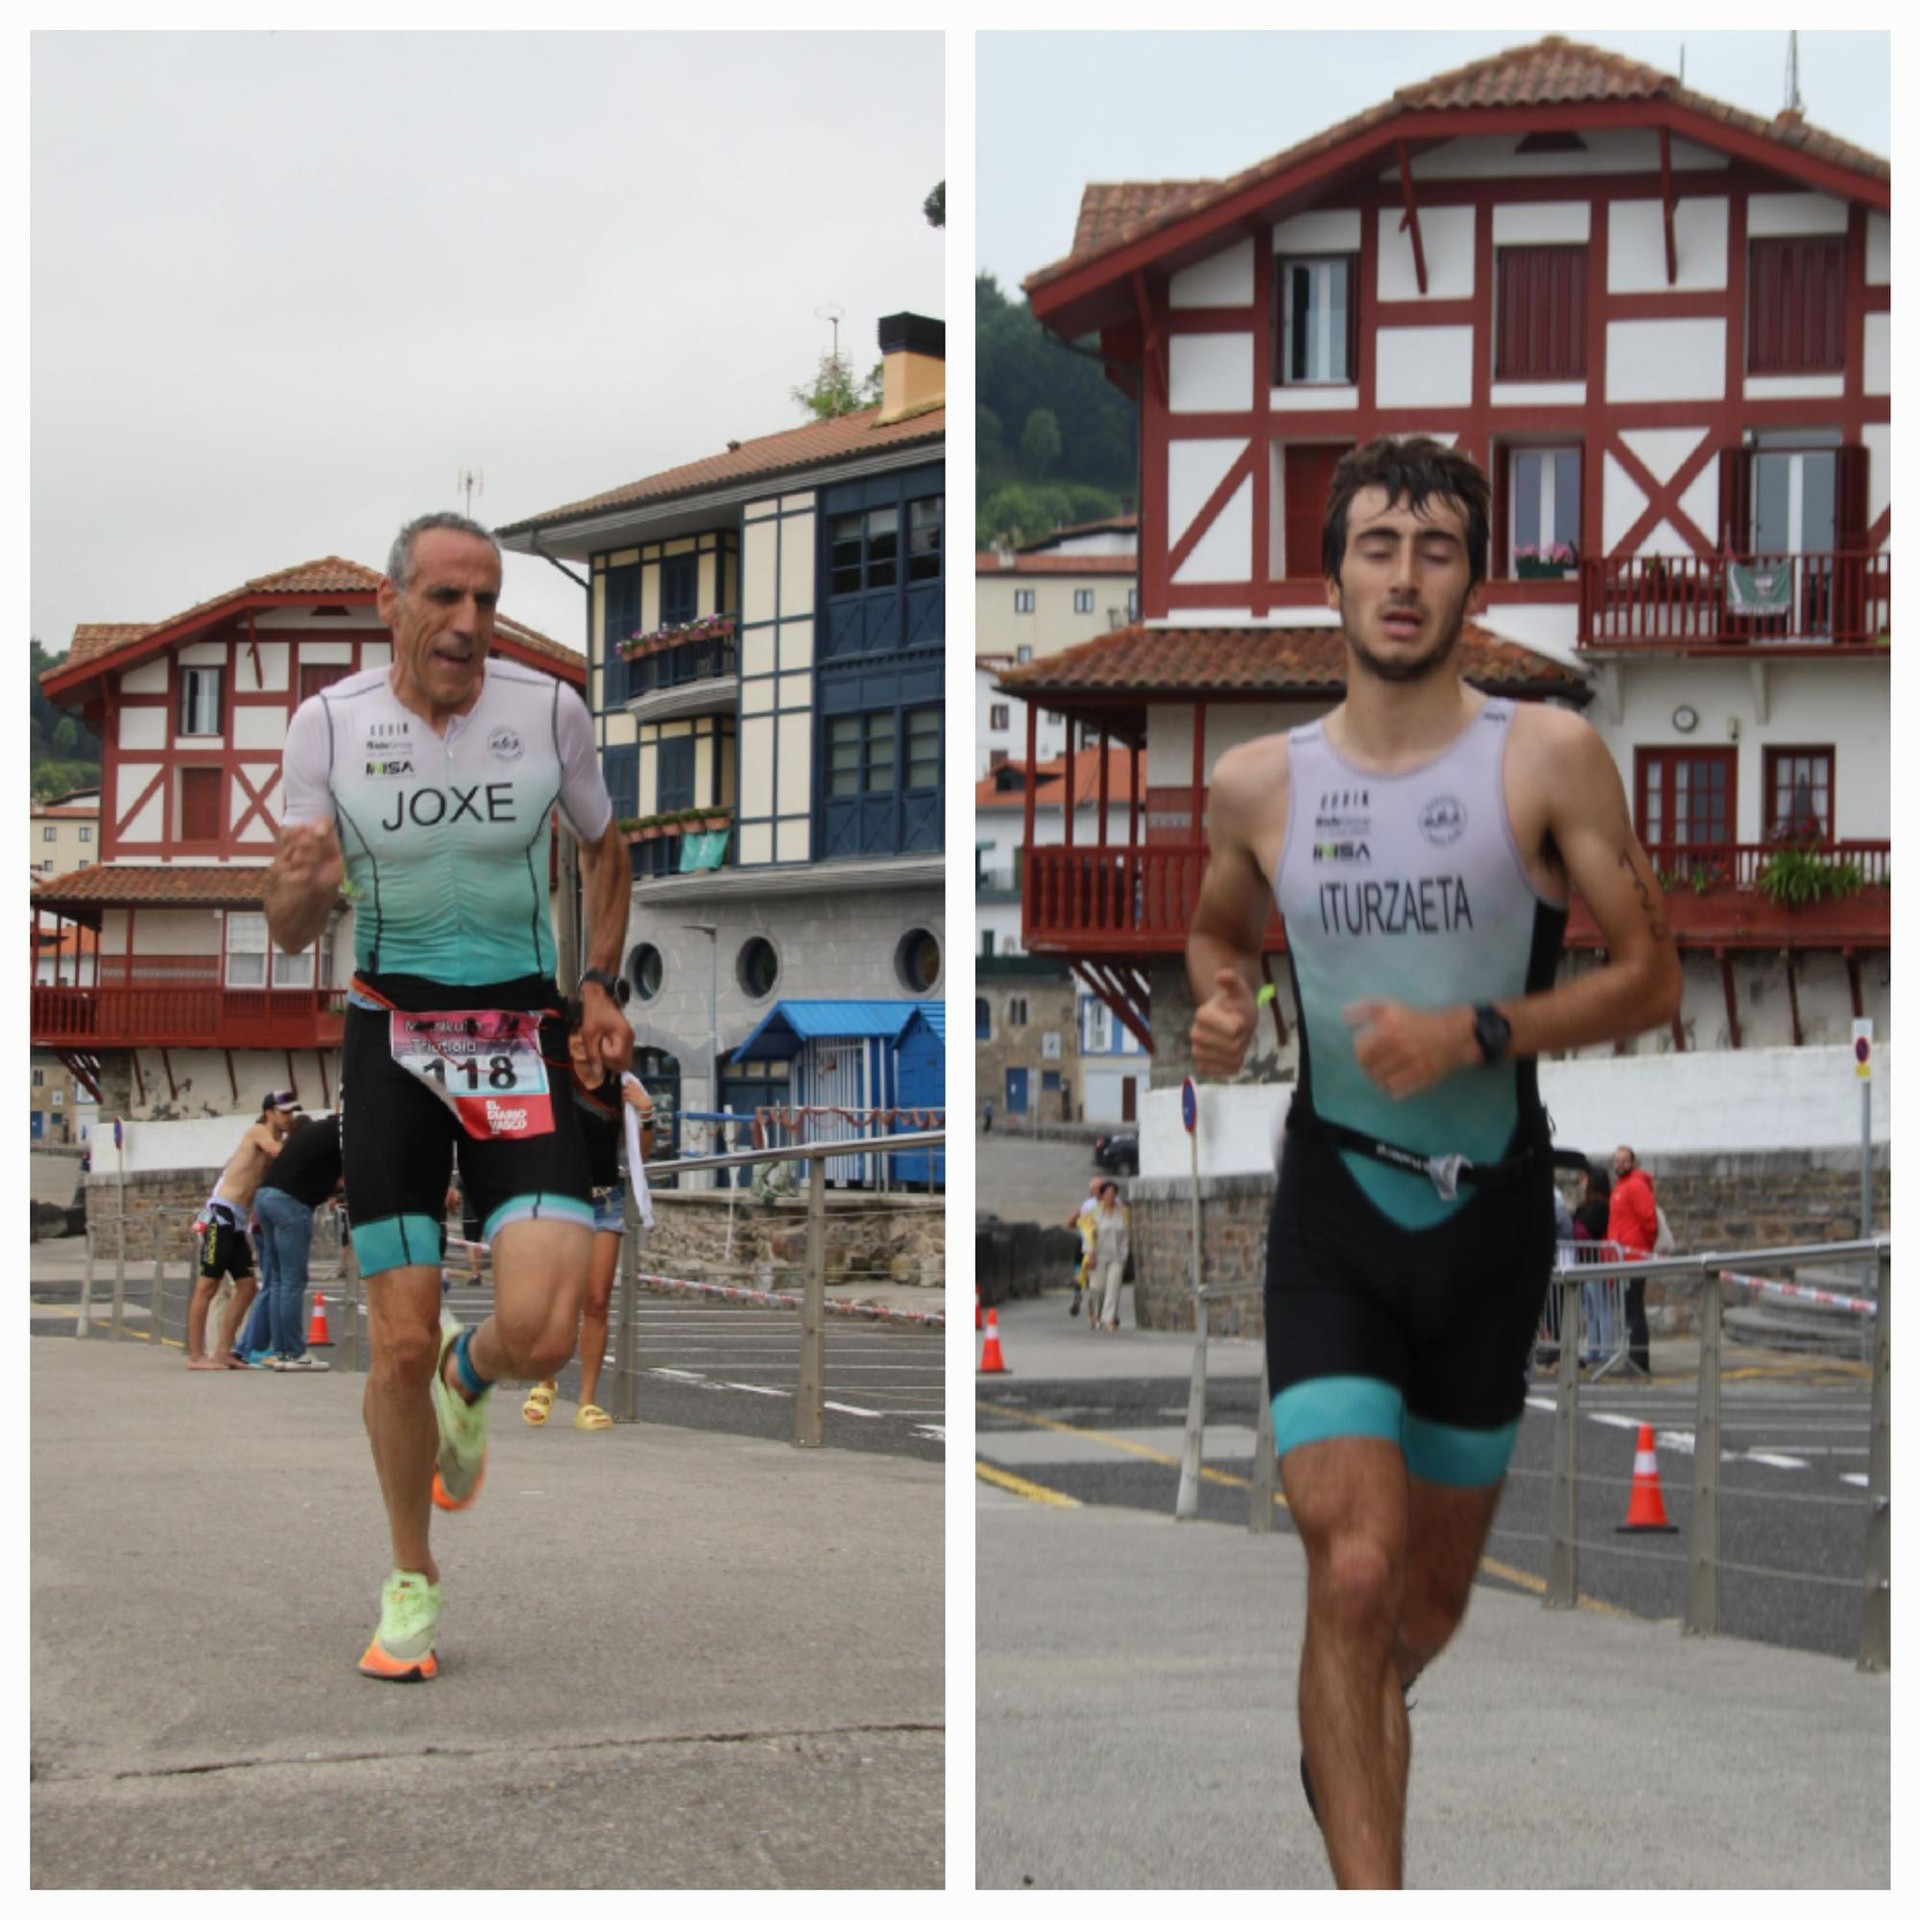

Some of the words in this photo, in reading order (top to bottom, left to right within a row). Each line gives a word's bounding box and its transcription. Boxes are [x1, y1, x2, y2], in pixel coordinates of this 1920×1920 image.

[382, 782, 517, 831] JOXE
[1319, 873, 1473, 936] ITURZAETA
[423, 1055, 518, 1091] 118
